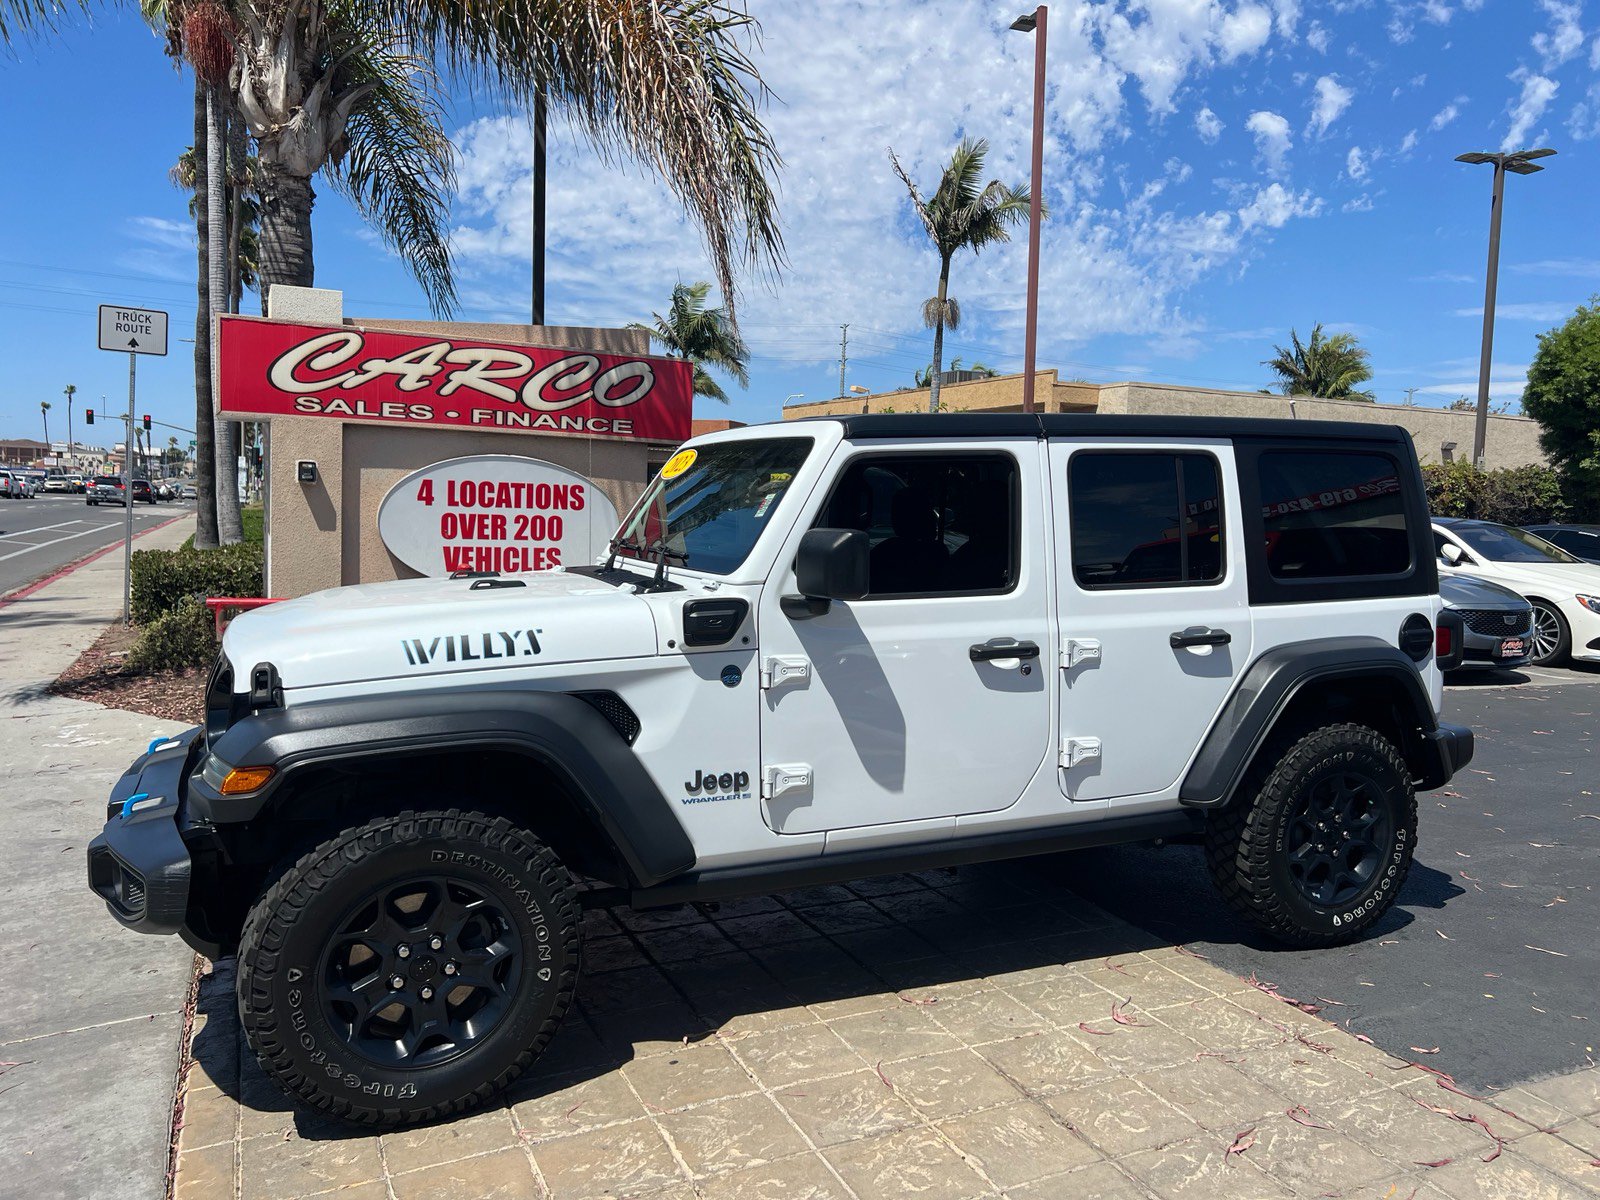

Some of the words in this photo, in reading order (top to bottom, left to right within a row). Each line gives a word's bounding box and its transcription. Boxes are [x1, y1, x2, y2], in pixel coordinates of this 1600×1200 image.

[115, 311, 152, 324] TRUCK
[115, 322, 152, 335] ROUTE
[267, 331, 656, 412] CARCO
[295, 395, 434, 421] SALES
[471, 408, 634, 435] FINANCE
[416, 479, 435, 506] 4
[447, 480, 585, 511] LOCATIONS
[440, 512, 507, 540] OVER
[513, 514, 563, 541] 200
[443, 546, 562, 573] VEHICLES
[401, 629, 543, 665] WILLYS
[684, 769, 750, 792] Jeep
[681, 794, 741, 805] WRANGLER
[431, 850, 552, 961] DESTINATION
